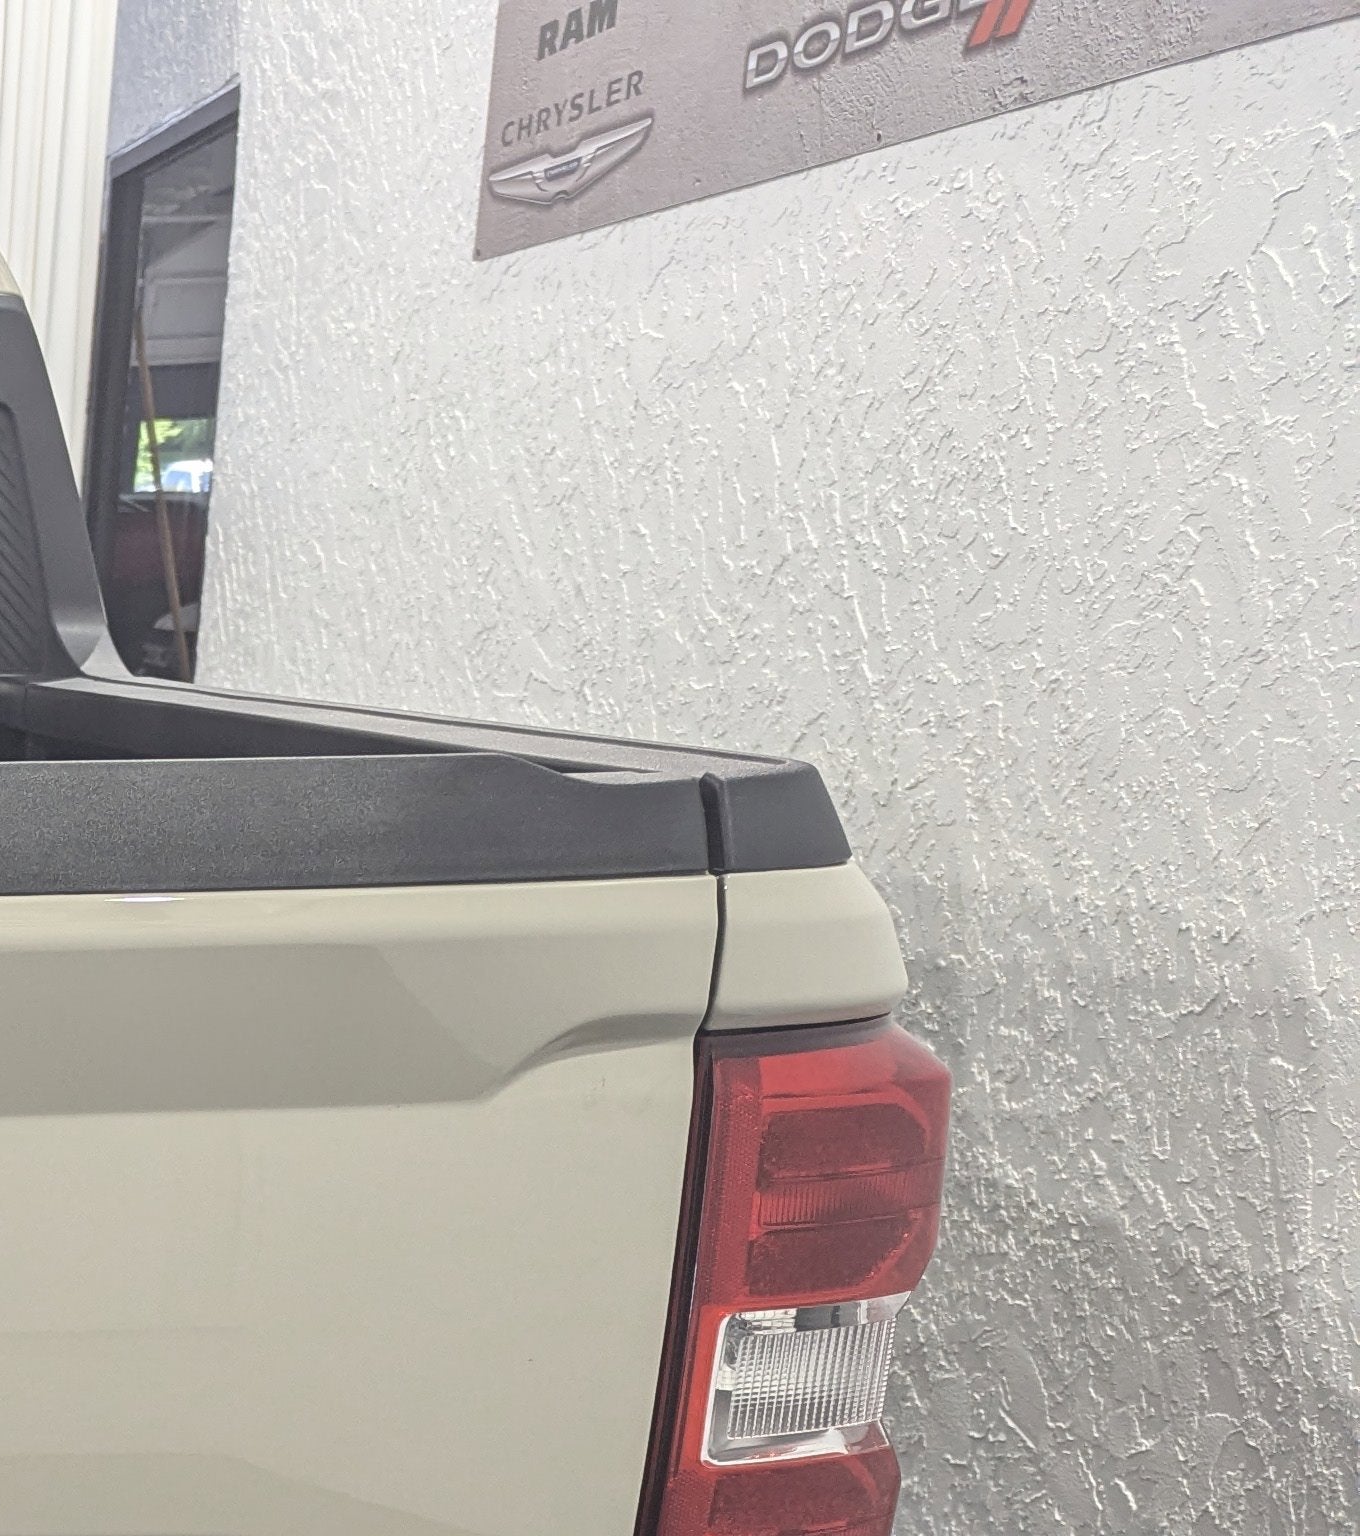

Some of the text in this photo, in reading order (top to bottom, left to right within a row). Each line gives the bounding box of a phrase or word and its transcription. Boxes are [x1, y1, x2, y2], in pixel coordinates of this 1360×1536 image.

[536, 0, 618, 61] RAM
[744, 0, 985, 89] DODG
[501, 70, 644, 147] CHRYSLER
